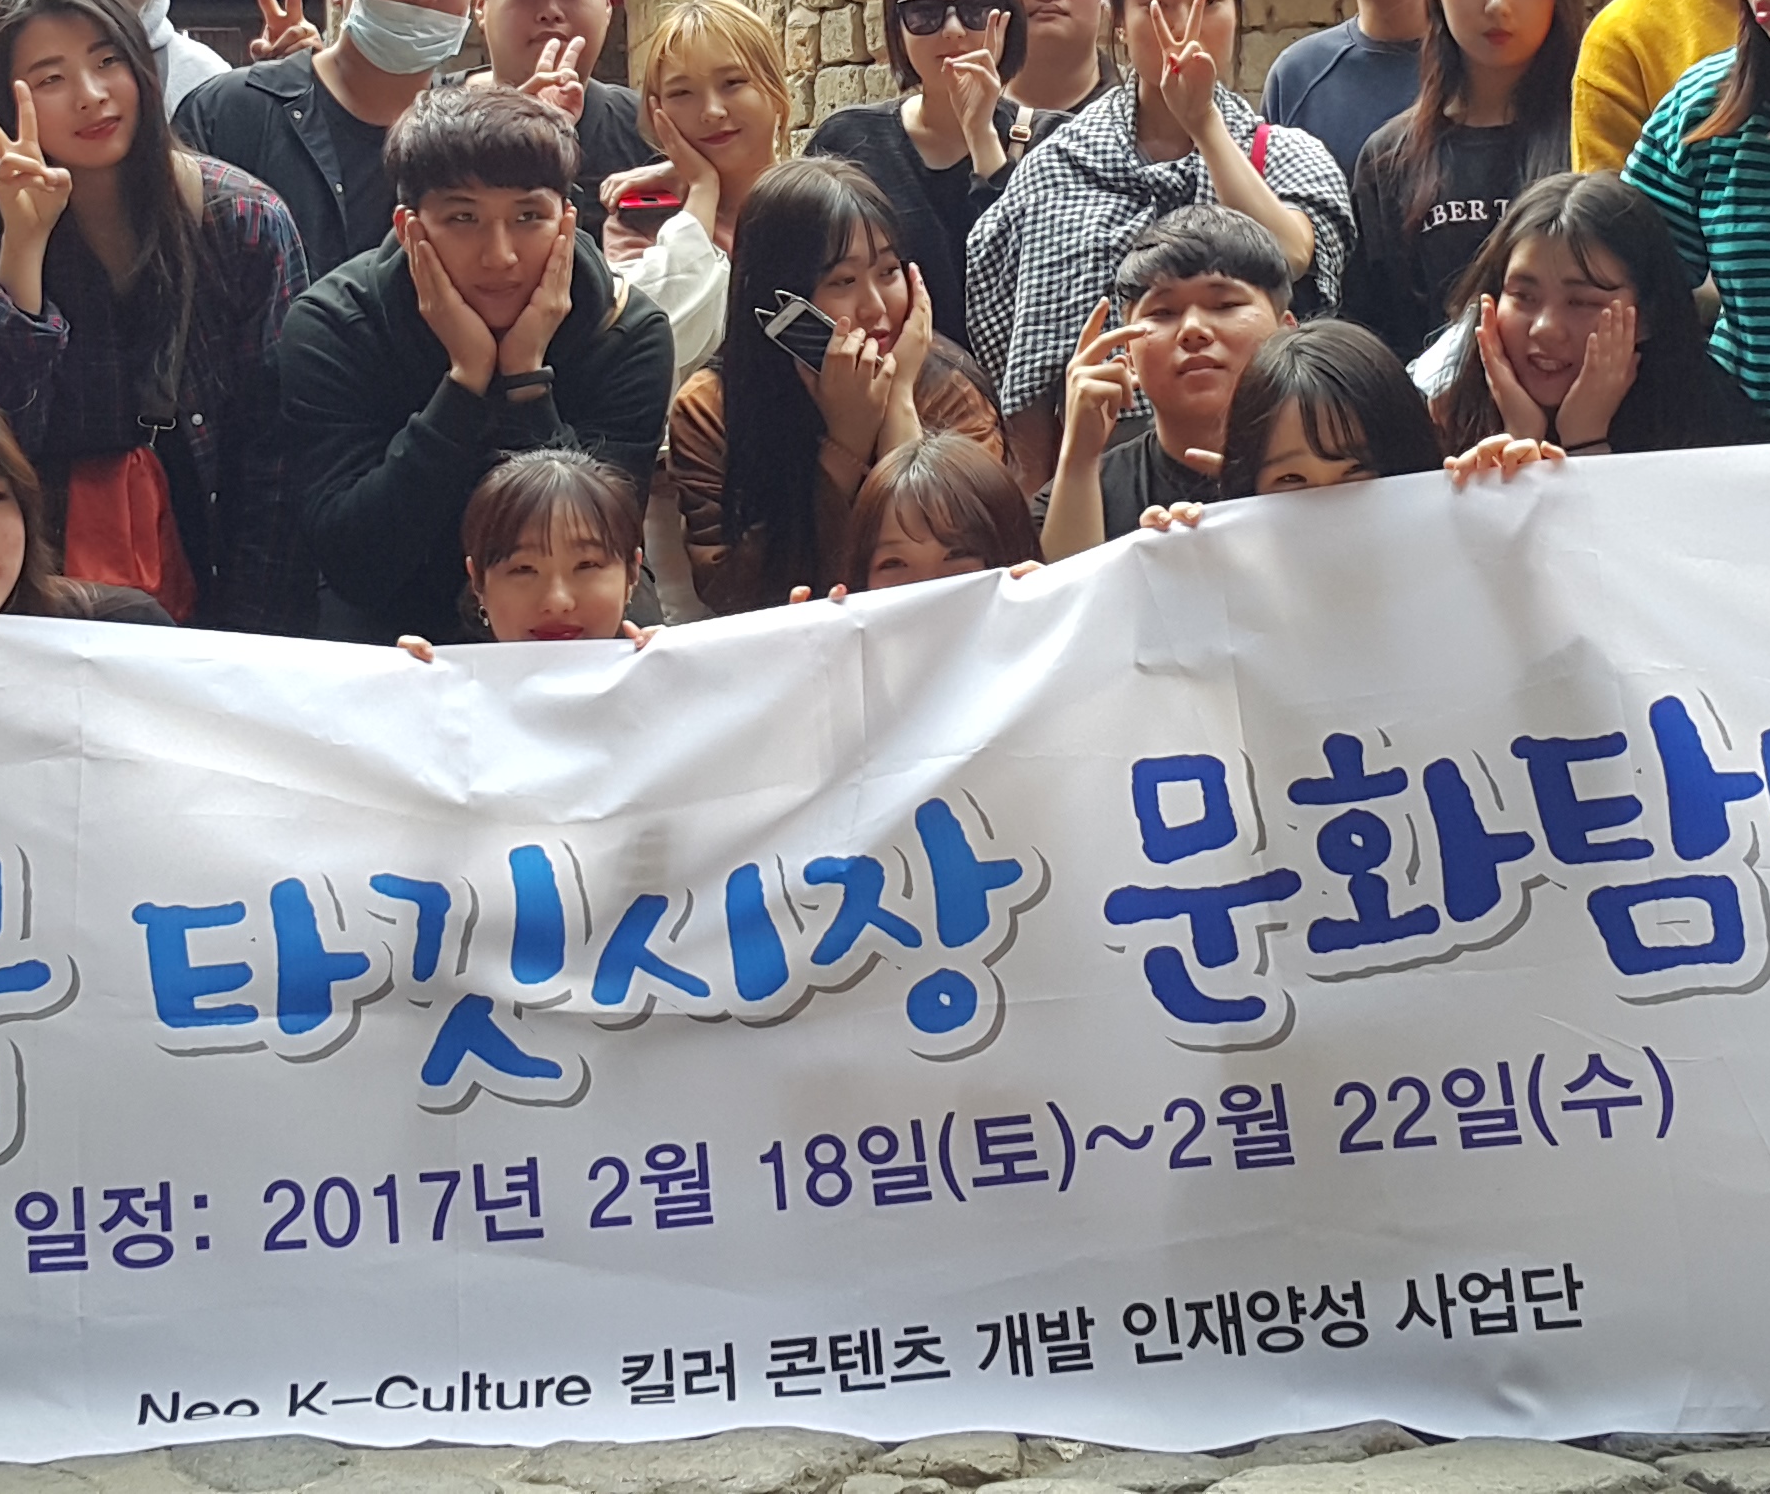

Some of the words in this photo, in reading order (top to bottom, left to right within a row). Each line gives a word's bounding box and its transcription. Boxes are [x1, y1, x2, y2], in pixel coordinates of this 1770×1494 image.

[13, 1182, 210, 1275] 일정:
[263, 1156, 545, 1252] 2017년
[589, 1141, 715, 1230] 2월
[1333, 1046, 1675, 1154] 22일(수)
[621, 1343, 736, 1405] 킬러
[765, 1328, 952, 1397] 콘텐츠
[976, 1306, 1096, 1378] 개발
[1122, 1281, 1369, 1365] 인재양성
[1395, 1262, 1585, 1340] 사업단
